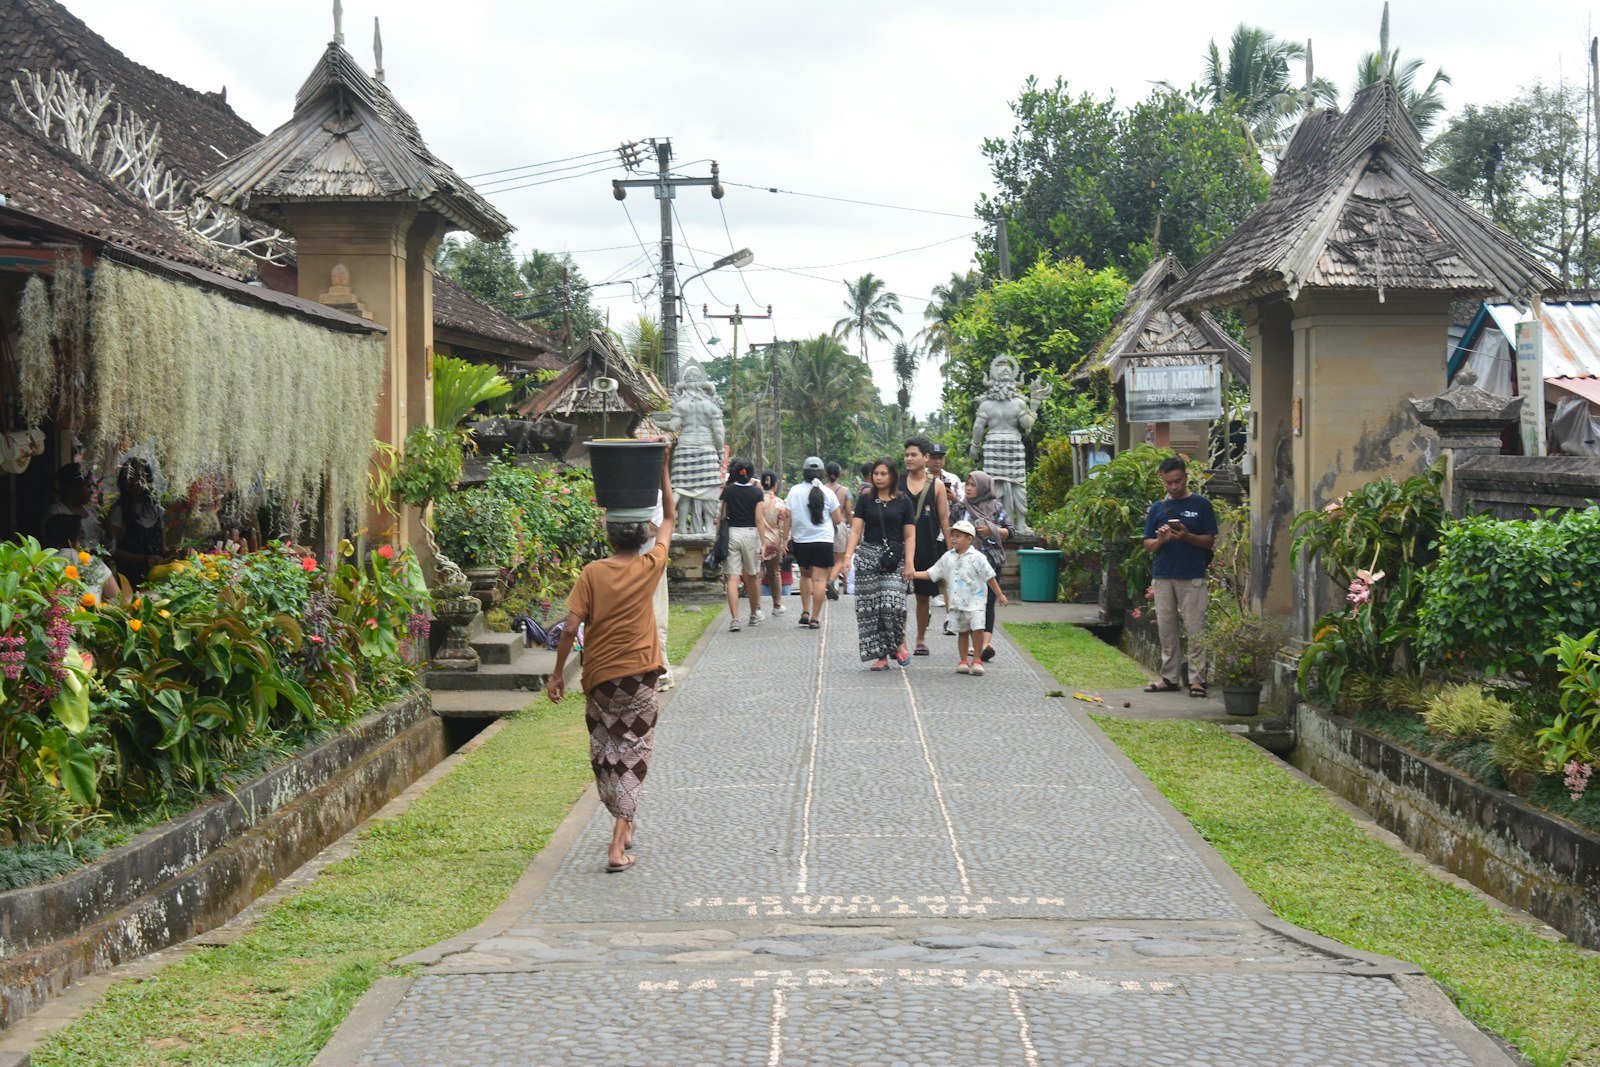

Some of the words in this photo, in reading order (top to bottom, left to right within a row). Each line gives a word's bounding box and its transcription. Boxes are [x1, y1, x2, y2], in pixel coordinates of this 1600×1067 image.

[1172, 369, 1217, 389] MEMADU
[685, 895, 782, 907] STEP
[791, 895, 904, 904] YOUR
[917, 895, 1065, 906] WATCH
